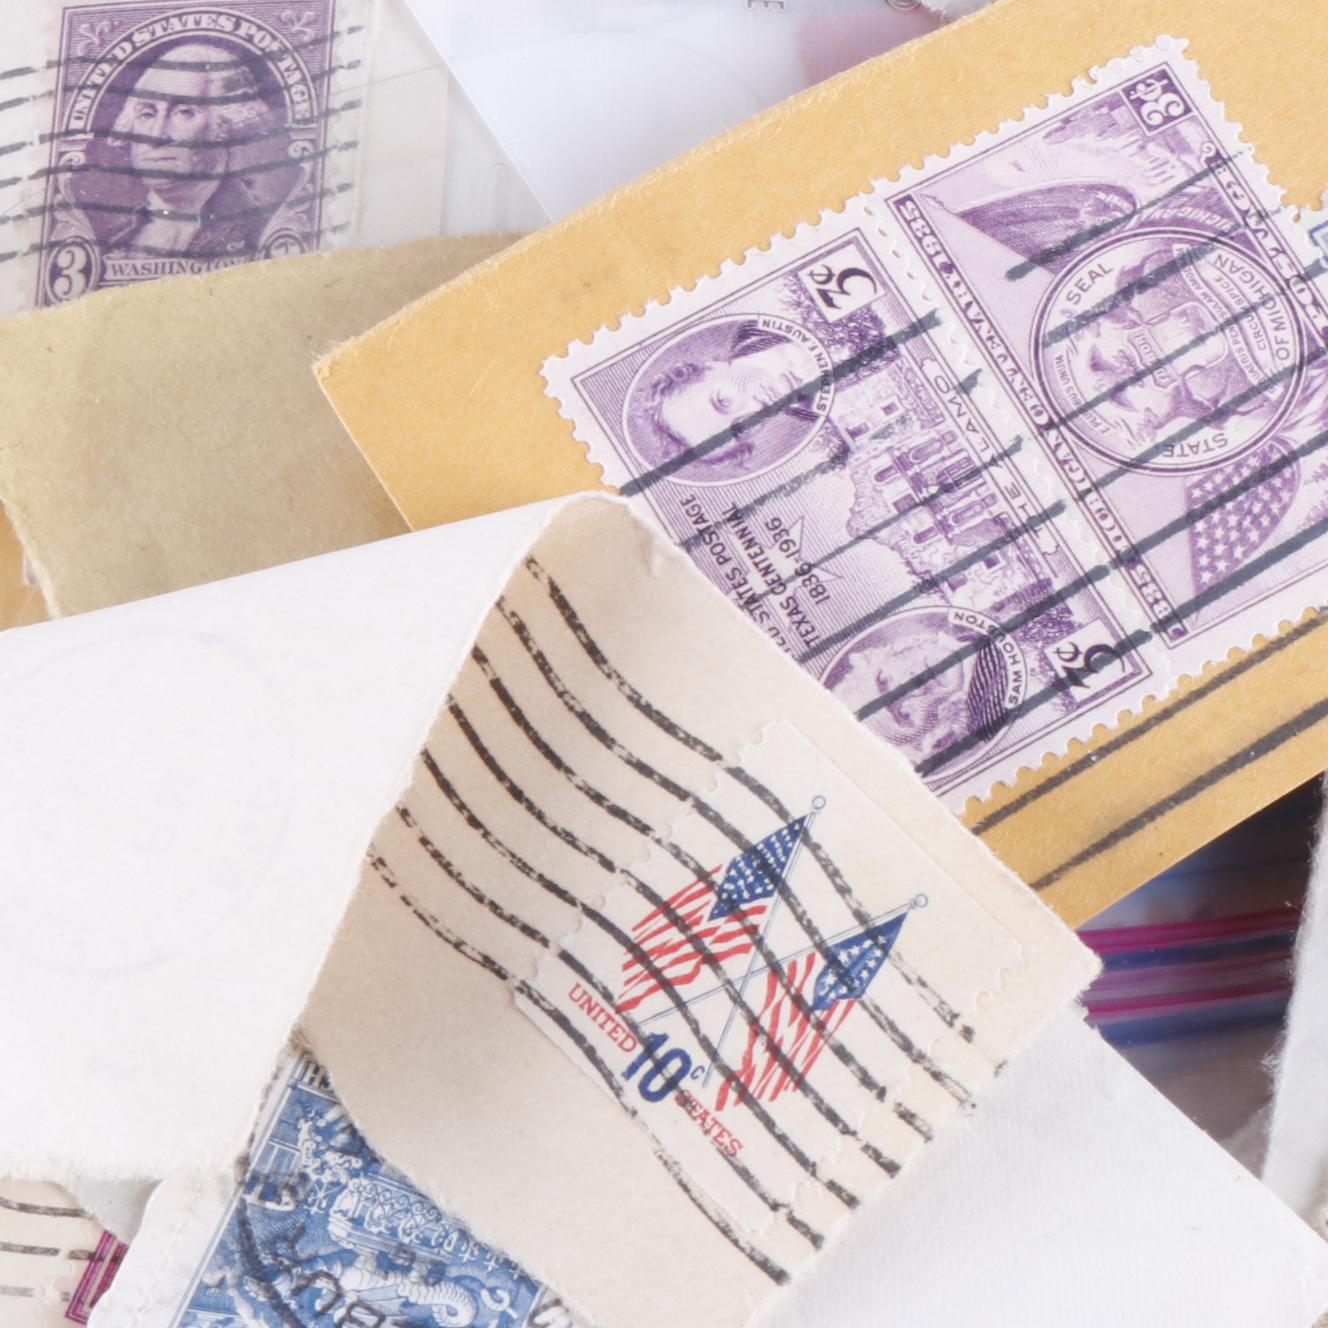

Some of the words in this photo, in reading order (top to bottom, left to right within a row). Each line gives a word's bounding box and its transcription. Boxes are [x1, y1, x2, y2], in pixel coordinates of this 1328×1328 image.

[134, 13, 237, 46] STATES
[896, 196, 947, 262] 1935
[51, 243, 93, 303] 3
[1065, 257, 1113, 303] SEAL
[1215, 251, 1291, 334] MICHIGAN
[761, 315, 811, 344] AUSTIN
[939, 266, 1052, 428] CENTENARY
[1277, 333, 1288, 359] OF
[928, 369, 1004, 474] ALAMO
[1163, 430, 1226, 456] STATE
[677, 490, 734, 566] POSTAGE
[717, 499, 790, 598] CENTENNIAL
[763, 513, 831, 607] 1836-1936
[723, 562, 772, 626] STATES
[777, 592, 822, 649] TEXAS
[954, 609, 1021, 666] HOUSTON
[1007, 663, 1026, 704] SAM
[567, 982, 641, 1054] UNITED
[674, 1088, 744, 1159] STATES
